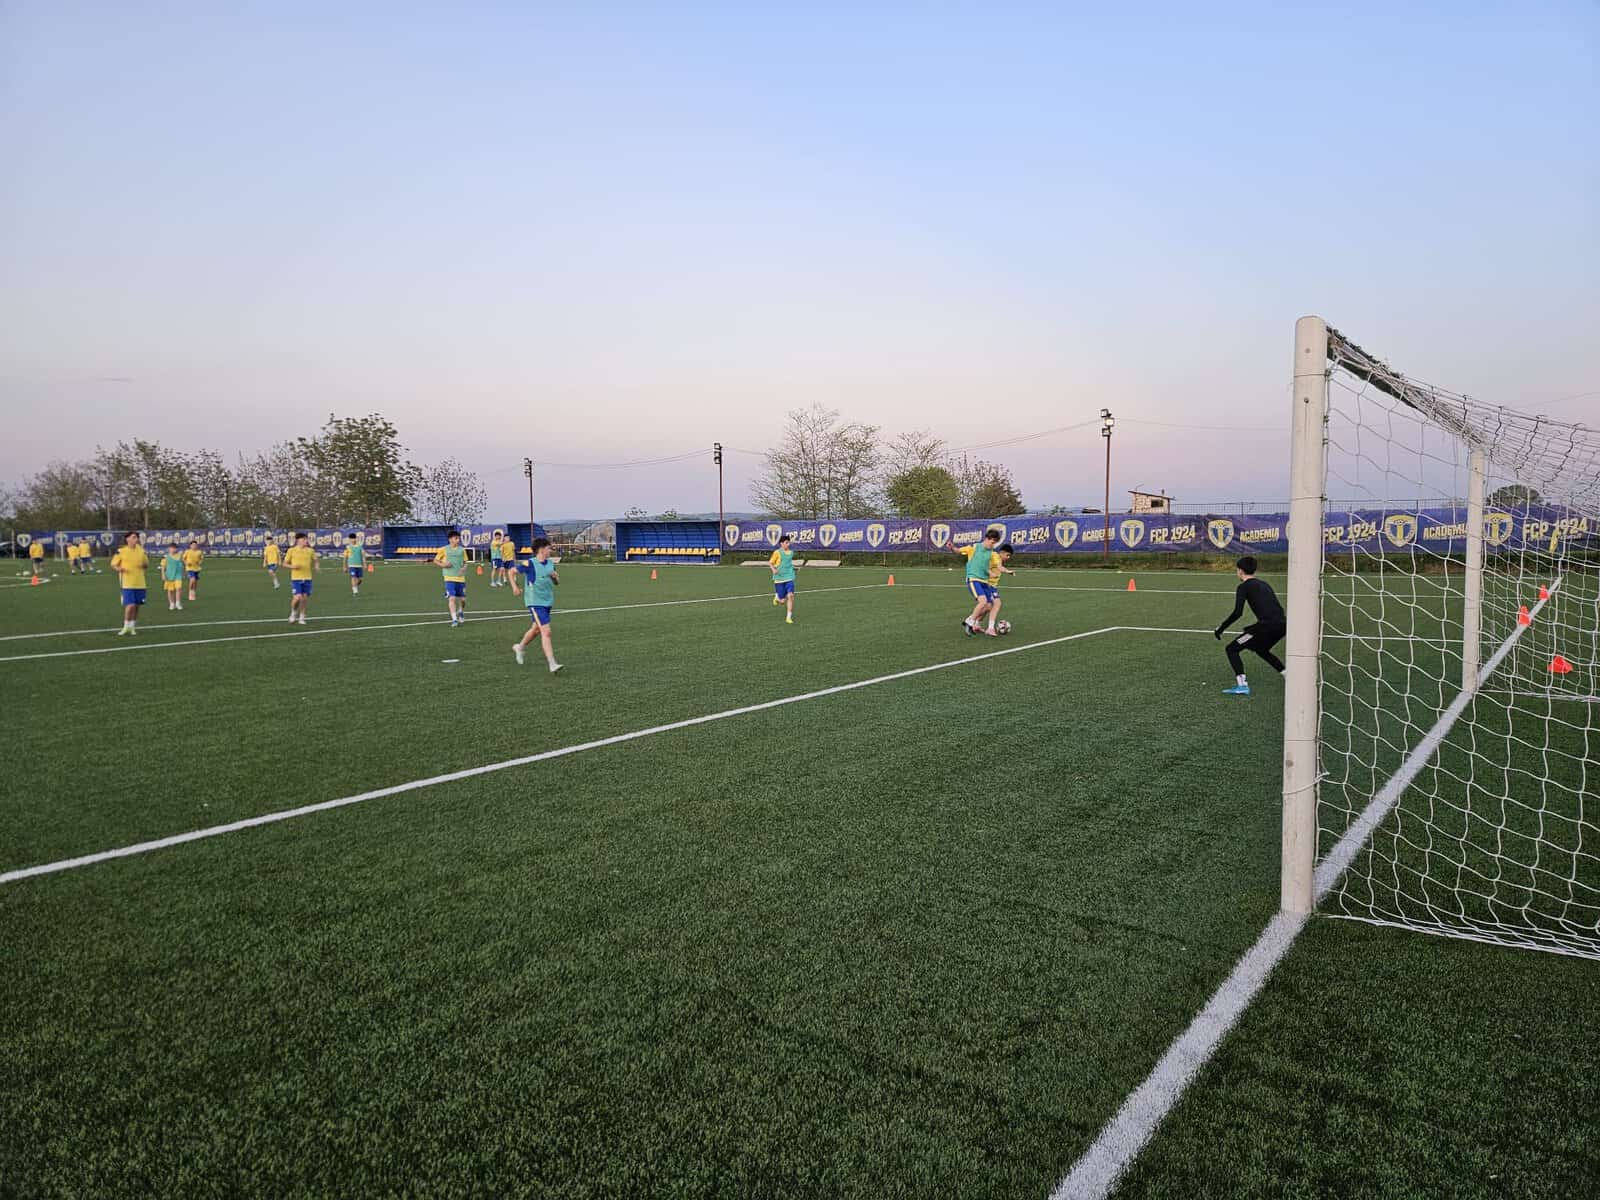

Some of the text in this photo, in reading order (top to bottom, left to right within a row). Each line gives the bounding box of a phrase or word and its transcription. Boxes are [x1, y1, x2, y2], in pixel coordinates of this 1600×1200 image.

[904, 528, 922, 543] 1924
[1011, 526, 1050, 544] FCP 1924
[1150, 525, 1195, 542] FCP 1924
[1240, 528, 1279, 542] ACADEMIA
[1347, 521, 1377, 539] 1924
[1423, 524, 1466, 539] ACADEMI
[1523, 521, 1549, 539] FCP
